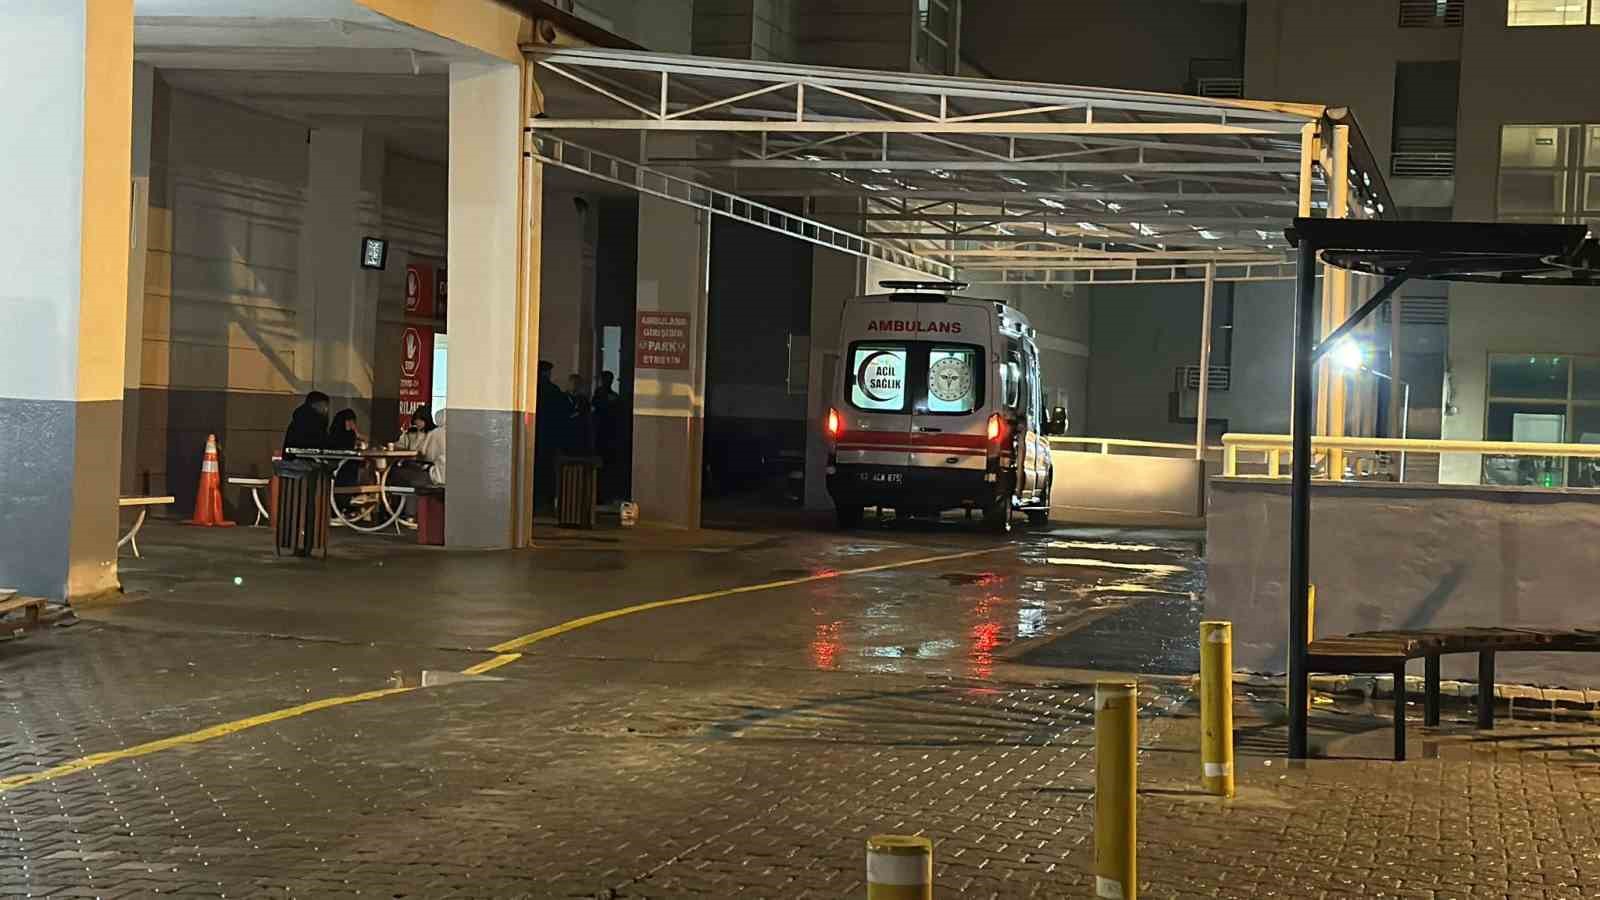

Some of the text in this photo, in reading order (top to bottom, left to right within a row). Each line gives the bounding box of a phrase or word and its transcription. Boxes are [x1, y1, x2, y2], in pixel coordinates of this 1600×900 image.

[867, 320, 962, 333] AMBULANS
[648, 341, 677, 352] PARK
[870, 378, 901, 389] SAĞLIK
